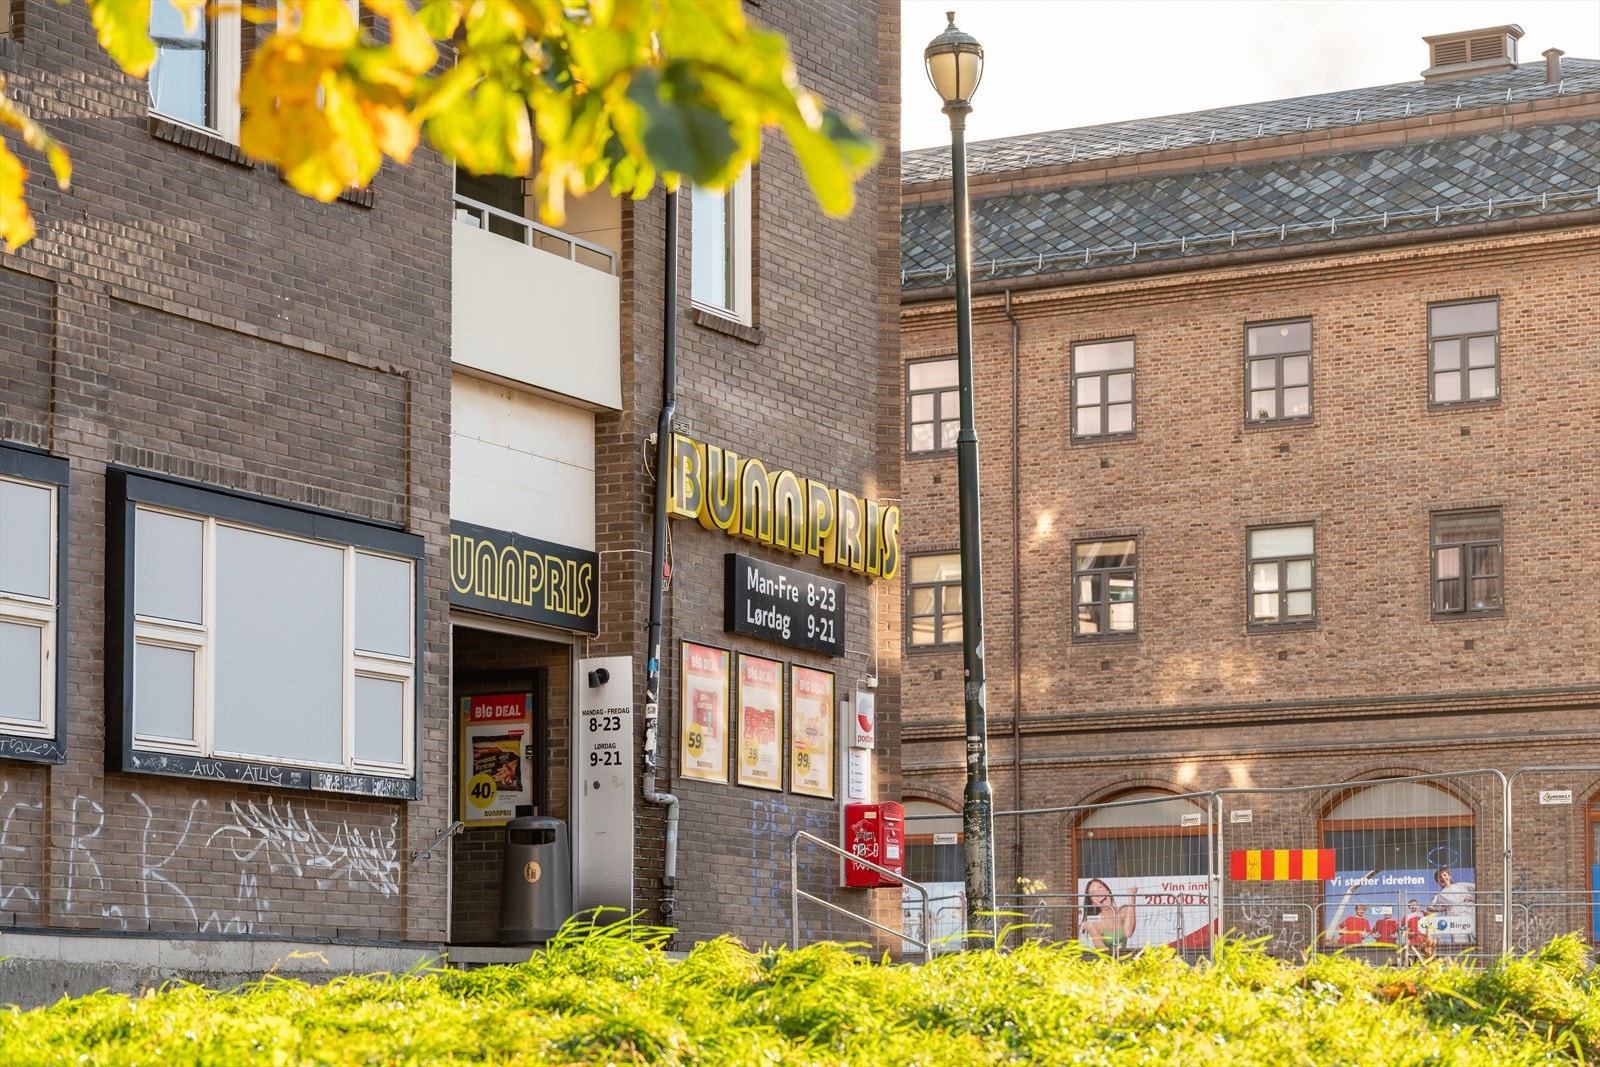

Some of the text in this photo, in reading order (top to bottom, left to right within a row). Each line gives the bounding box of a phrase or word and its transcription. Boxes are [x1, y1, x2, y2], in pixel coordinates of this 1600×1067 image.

[666, 432, 900, 580] BUNNPRIS
[450, 534, 592, 617] UNNPRIS
[747, 566, 836, 612] Man-Fre 8-23
[747, 599, 836, 643] Lørdag 9-21
[495, 704, 522, 717] DEAL
[581, 708, 604, 716] MANDAG
[607, 707, 630, 715] FREDAG
[589, 716, 621, 732] 8-23
[594, 742, 617, 750] LØRDAG
[590, 751, 622, 766] 9-21
[1161, 881, 1209, 891] Vinn innt
[1330, 875, 1425, 887] Vi støtter idretten
[1450, 922, 1471, 930] Bingo
